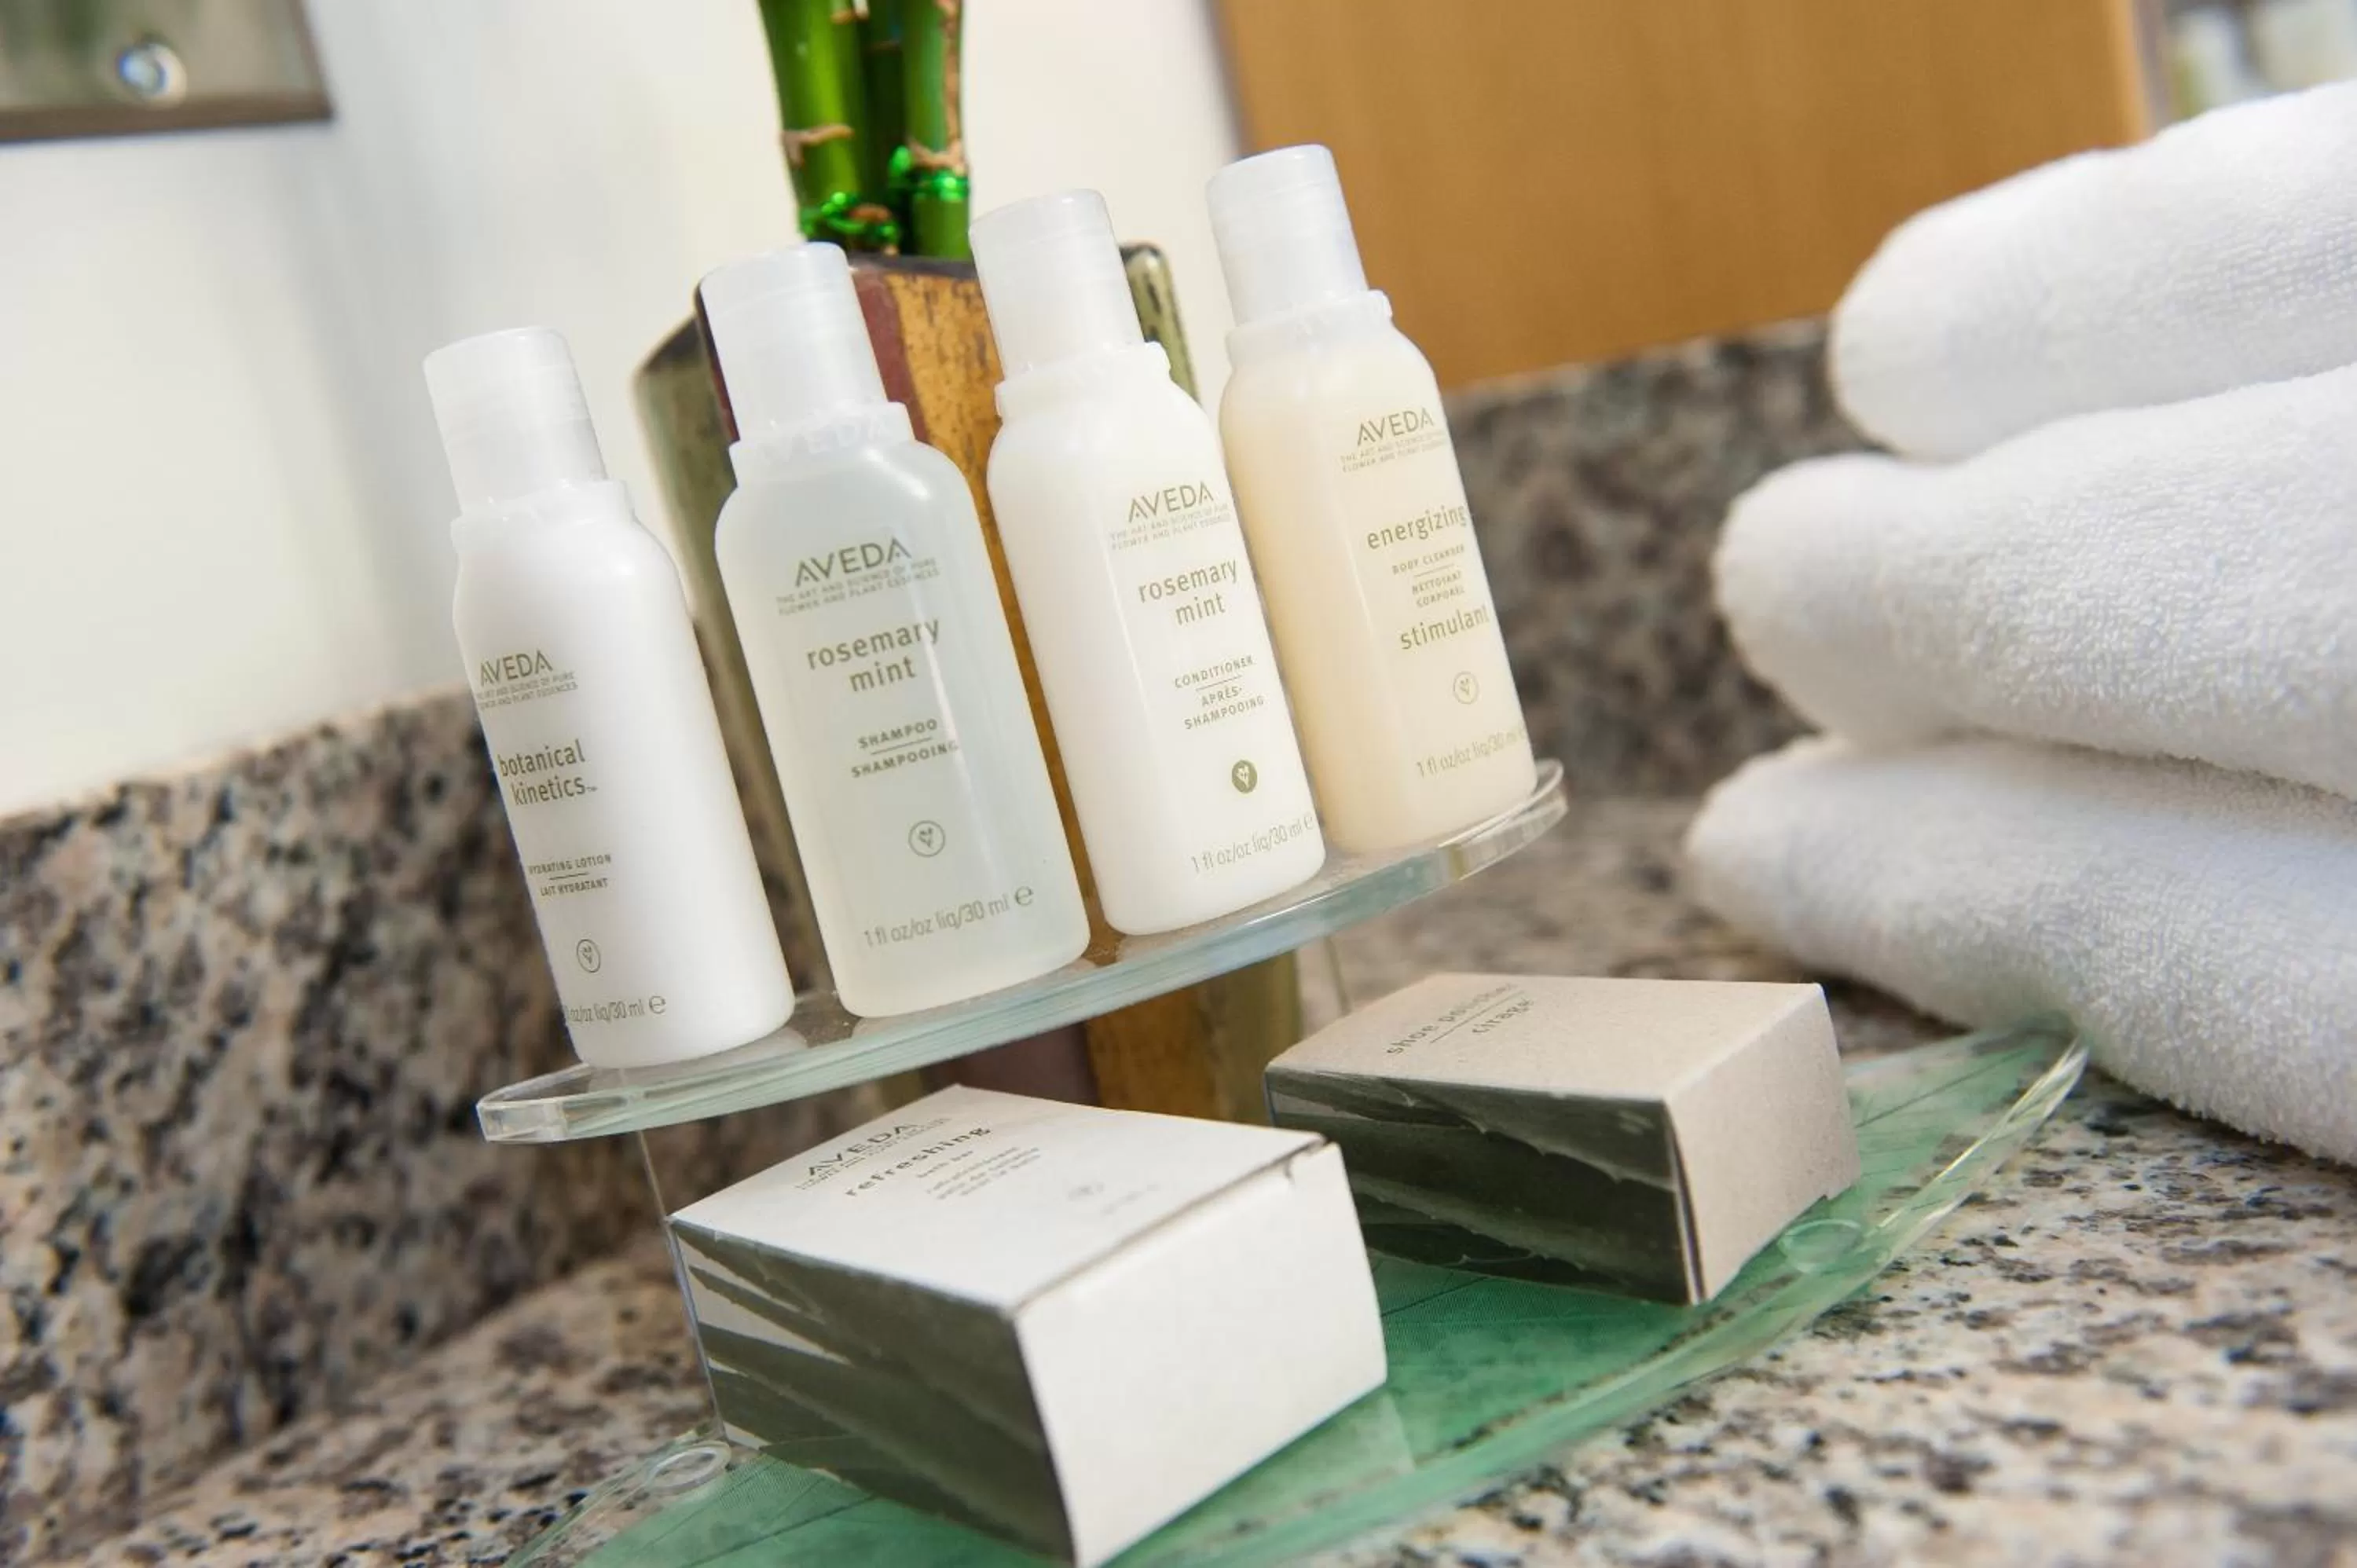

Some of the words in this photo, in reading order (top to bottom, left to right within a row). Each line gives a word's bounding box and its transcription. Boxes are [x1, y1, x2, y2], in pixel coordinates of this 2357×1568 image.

[1357, 407, 1434, 446] AVEDA
[1128, 481, 1214, 523] AVEDA
[1367, 504, 1467, 550] energizing
[795, 536, 911, 588] AVEDA
[1138, 559, 1237, 603] rosemary
[1175, 593, 1226, 625] mint
[807, 618, 939, 670] rosemary
[480, 649, 553, 687] AVEDA
[849, 654, 917, 692] mint
[1175, 654, 1254, 688] CONDITIONER
[1184, 695, 1264, 730] SHAMPOOING
[858, 718, 937, 749] SHAMPOO
[497, 738, 585, 777] botanical
[851, 740, 959, 778] SHAMPOOING
[575, 854, 611, 868] LOTION
[864, 929, 874, 948] 1
[874, 925, 887, 945] fl
[890, 917, 933, 943] oz/oz
[935, 899, 985, 930] liq/30
[988, 893, 1010, 917] ml
[1386, 1024, 1439, 1054] shoe
[809, 1123, 919, 1176] AVEDA
[845, 1127, 992, 1198] refreshing
